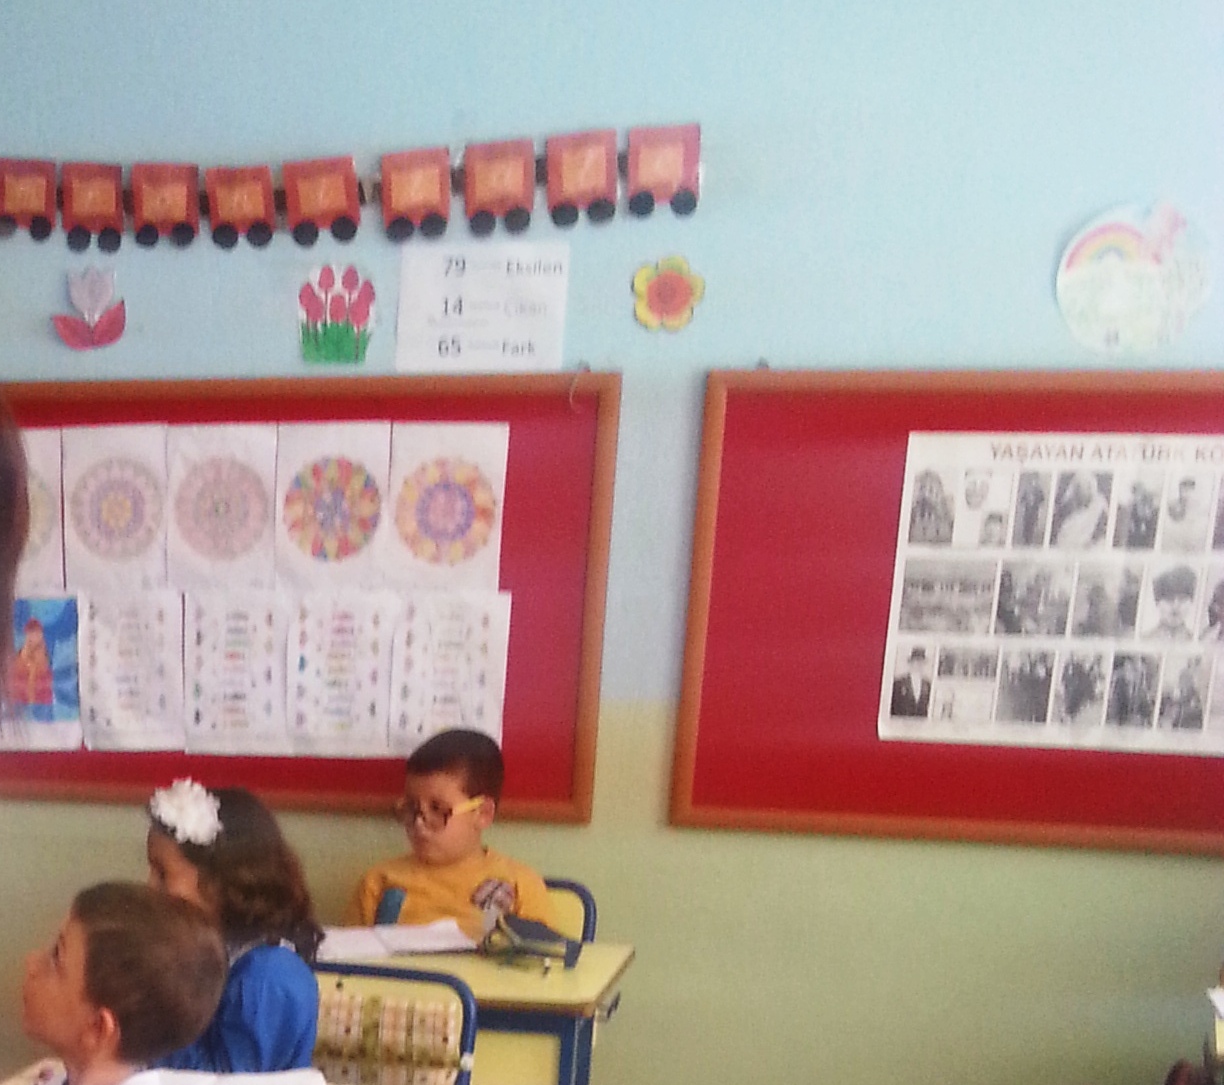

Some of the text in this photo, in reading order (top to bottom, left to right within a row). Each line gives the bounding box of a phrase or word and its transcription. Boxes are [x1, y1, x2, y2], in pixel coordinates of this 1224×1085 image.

[443, 255, 467, 278] 79
[442, 295, 464, 317] 14
[437, 334, 462, 358] 65
[990, 441, 1085, 464] YAŞAYAN
[1089, 441, 1185, 463] ATAÜRK
